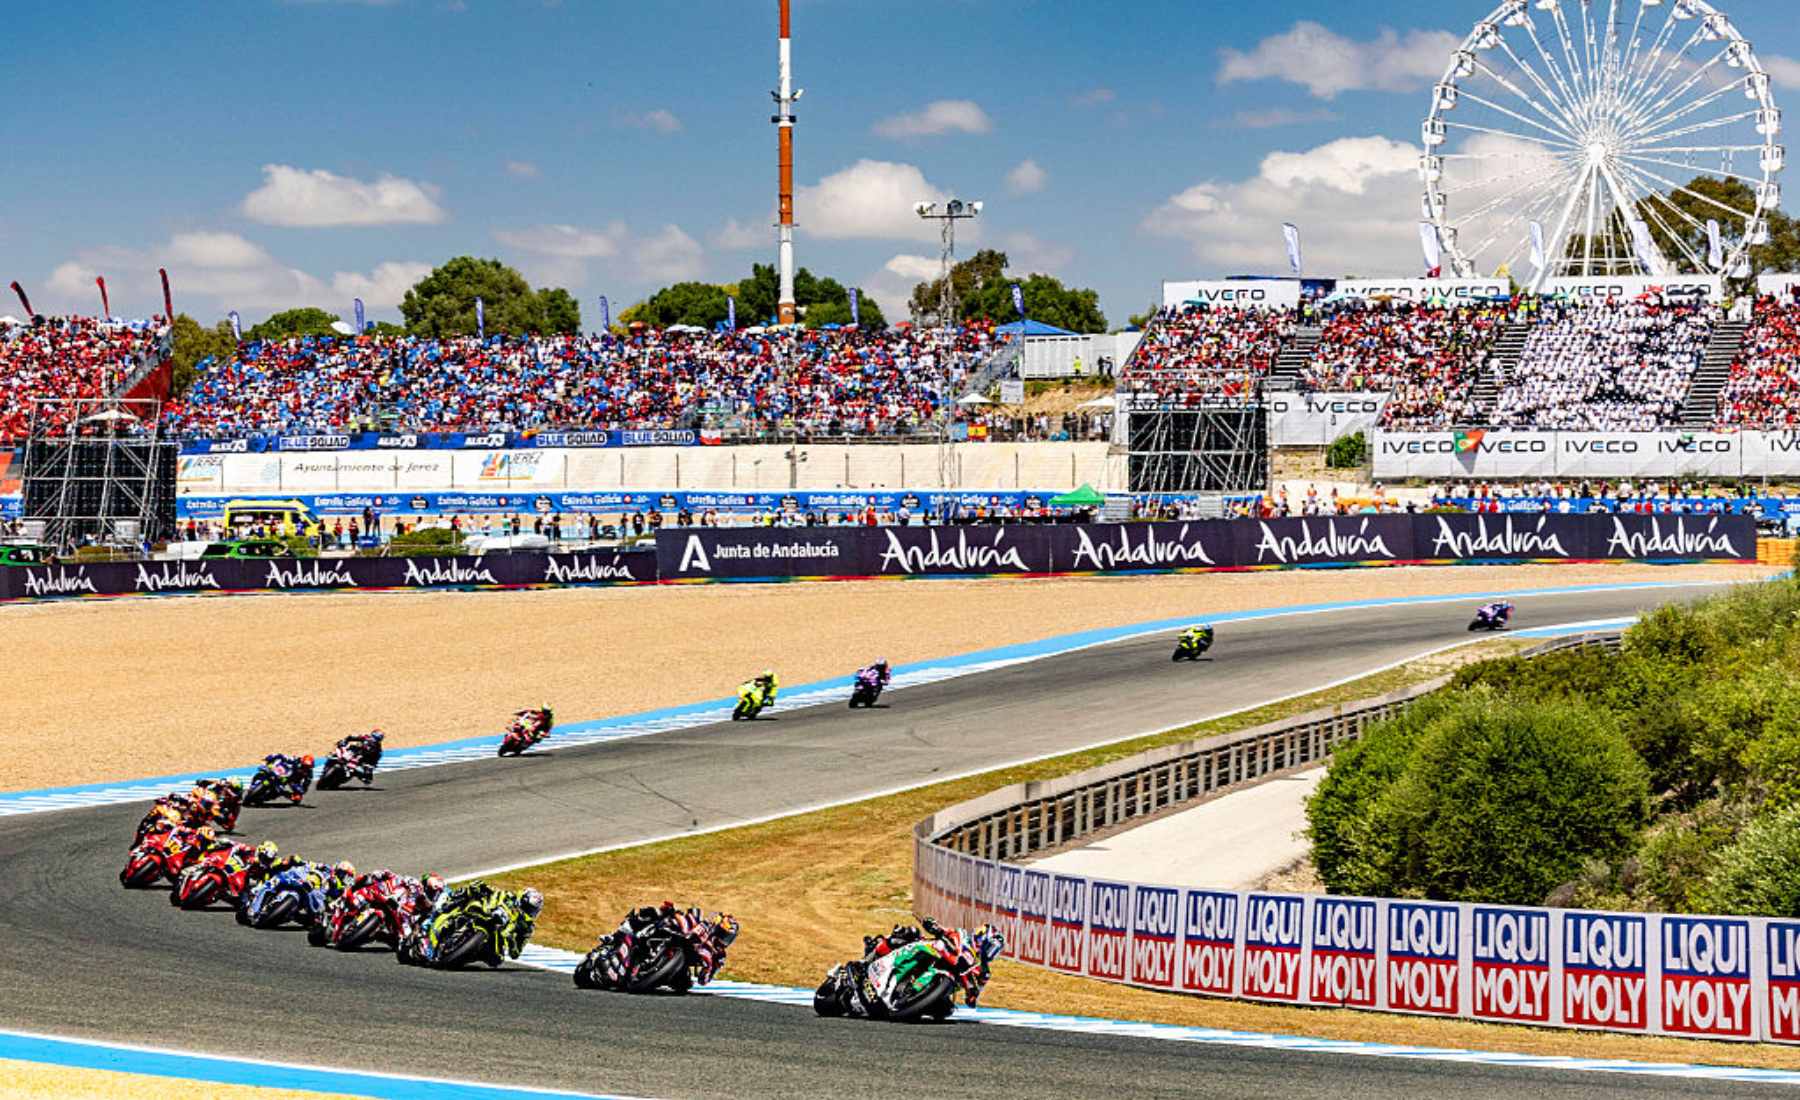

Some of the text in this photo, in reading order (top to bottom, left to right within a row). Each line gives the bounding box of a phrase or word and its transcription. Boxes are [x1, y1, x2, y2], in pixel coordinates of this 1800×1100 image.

[1307, 401, 1377, 413] IVECO
[1383, 440, 1455, 453] IVECO
[1479, 440, 1546, 453] VECO
[1565, 440, 1638, 452] IVECO
[1658, 440, 1731, 452] IVECO
[713, 540, 839, 559] Junta de Andalucía
[880, 528, 1031, 573] Andalucía
[1072, 523, 1216, 569] Andalucía
[1255, 517, 1396, 563] Andalucía
[1432, 514, 1570, 558] Andalucía
[1606, 515, 1742, 558] Andalucía
[23, 567, 98, 596] Andalucía
[135, 559, 221, 592] Andalucía
[265, 559, 358, 589] Andalucía
[403, 557, 499, 586] Andalucía
[544, 555, 637, 582] Andalucía
[1092, 885, 1129, 929] LIQUI
[1136, 889, 1177, 936] LIQUI
[1188, 894, 1235, 940] LIQUI
[1247, 899, 1302, 945] LIQUI
[1314, 902, 1374, 950] LIQUI
[1051, 924, 1083, 967] MOLY
[1390, 907, 1456, 957] LIQUI
[1475, 912, 1546, 963] LIQUI
[1566, 917, 1643, 970] LIQUI
[1664, 922, 1747, 976] LIQUI
[1770, 927, 1800, 977] LI
[1089, 933, 1126, 978] MOLY
[1133, 939, 1175, 984] MOLY
[1184, 945, 1234, 990] MOLY
[1244, 949, 1300, 995] MOLY
[1312, 954, 1376, 1001] MOLY
[1390, 960, 1458, 1009] MOLY
[1475, 967, 1549, 1017] MOLY
[1566, 972, 1645, 1025] MOLY
[1664, 979, 1750, 1030] MOLY
